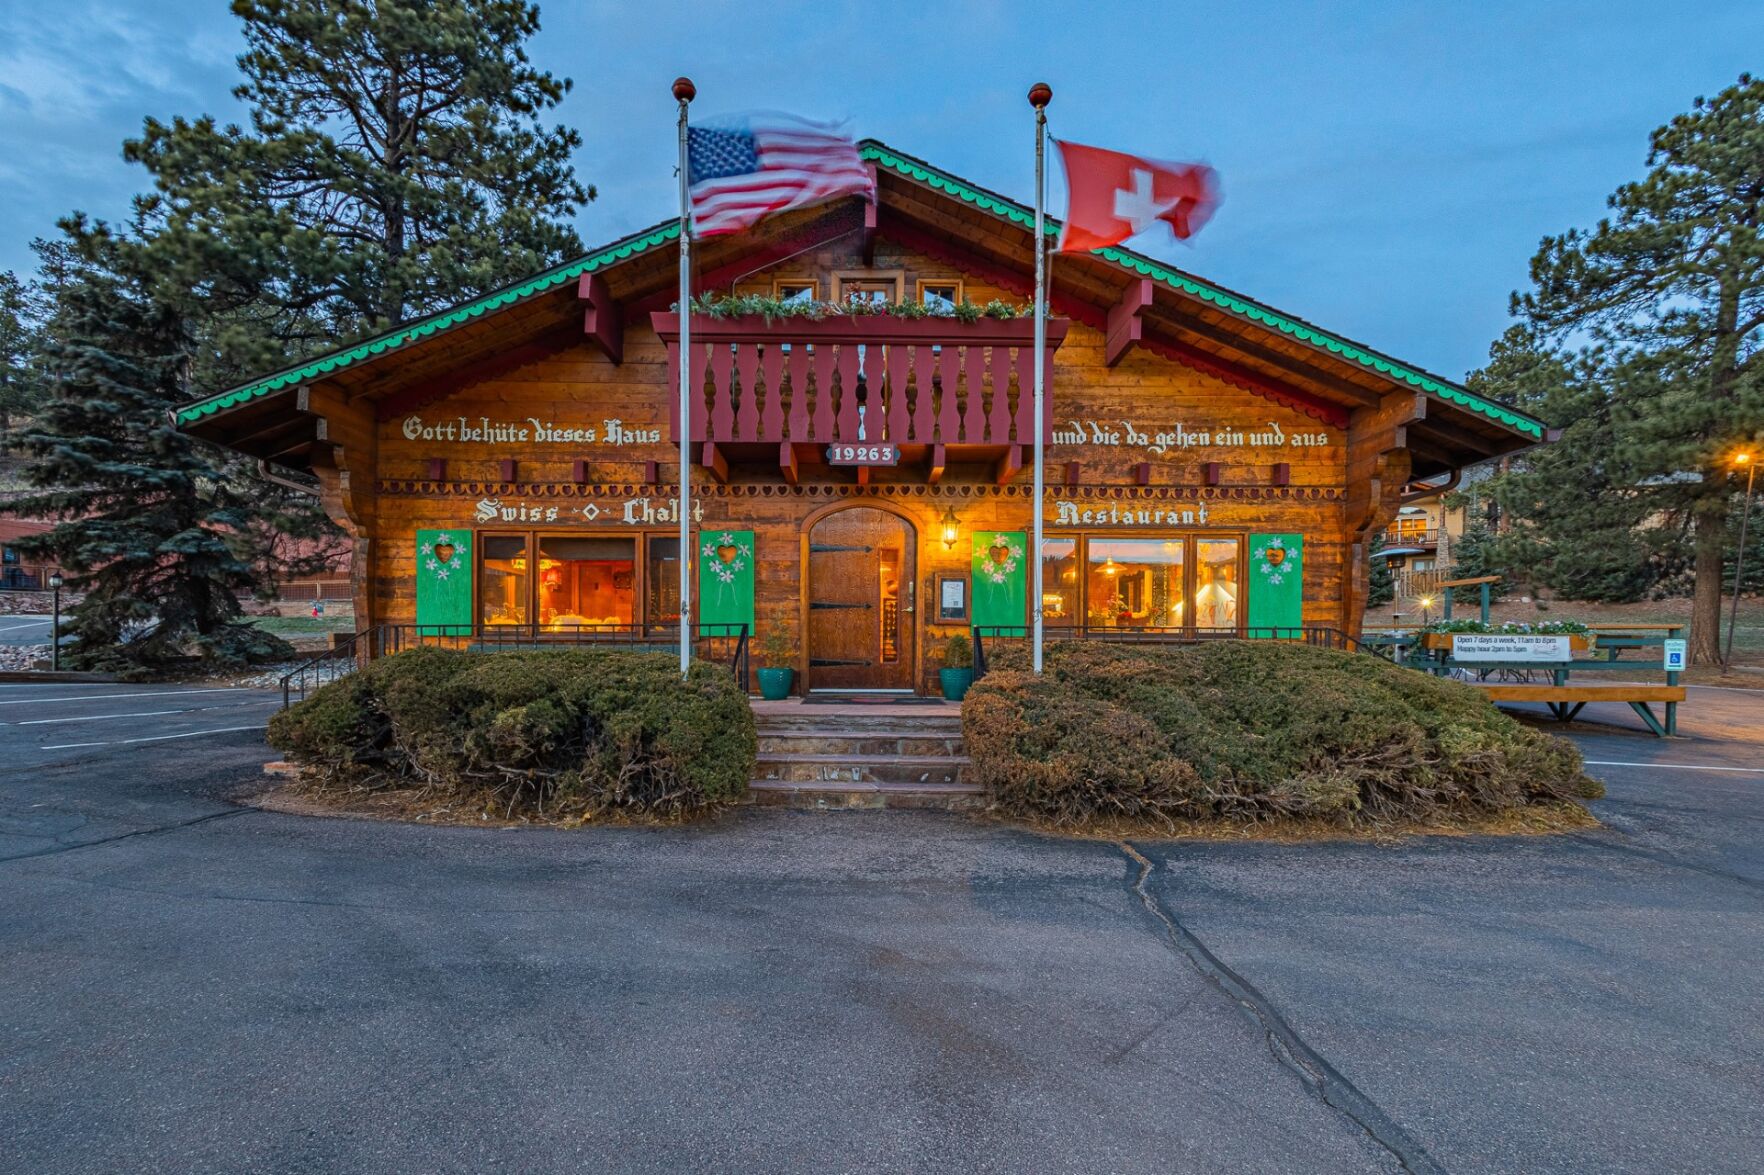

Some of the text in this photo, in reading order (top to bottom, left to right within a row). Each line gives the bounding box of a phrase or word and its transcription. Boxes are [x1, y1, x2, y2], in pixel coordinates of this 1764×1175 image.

[402, 415, 661, 446] Gott behüte dieses Haus
[1051, 421, 1329, 454] und die da gehen ein und aus
[834, 447, 893, 461] 19263
[473, 497, 705, 525] Swiss Chalt
[1055, 501, 1210, 525] Restaurant
[1457, 636, 1473, 644] Open
[1478, 637, 1493, 645] days
[1457, 645, 1476, 653] Happy
